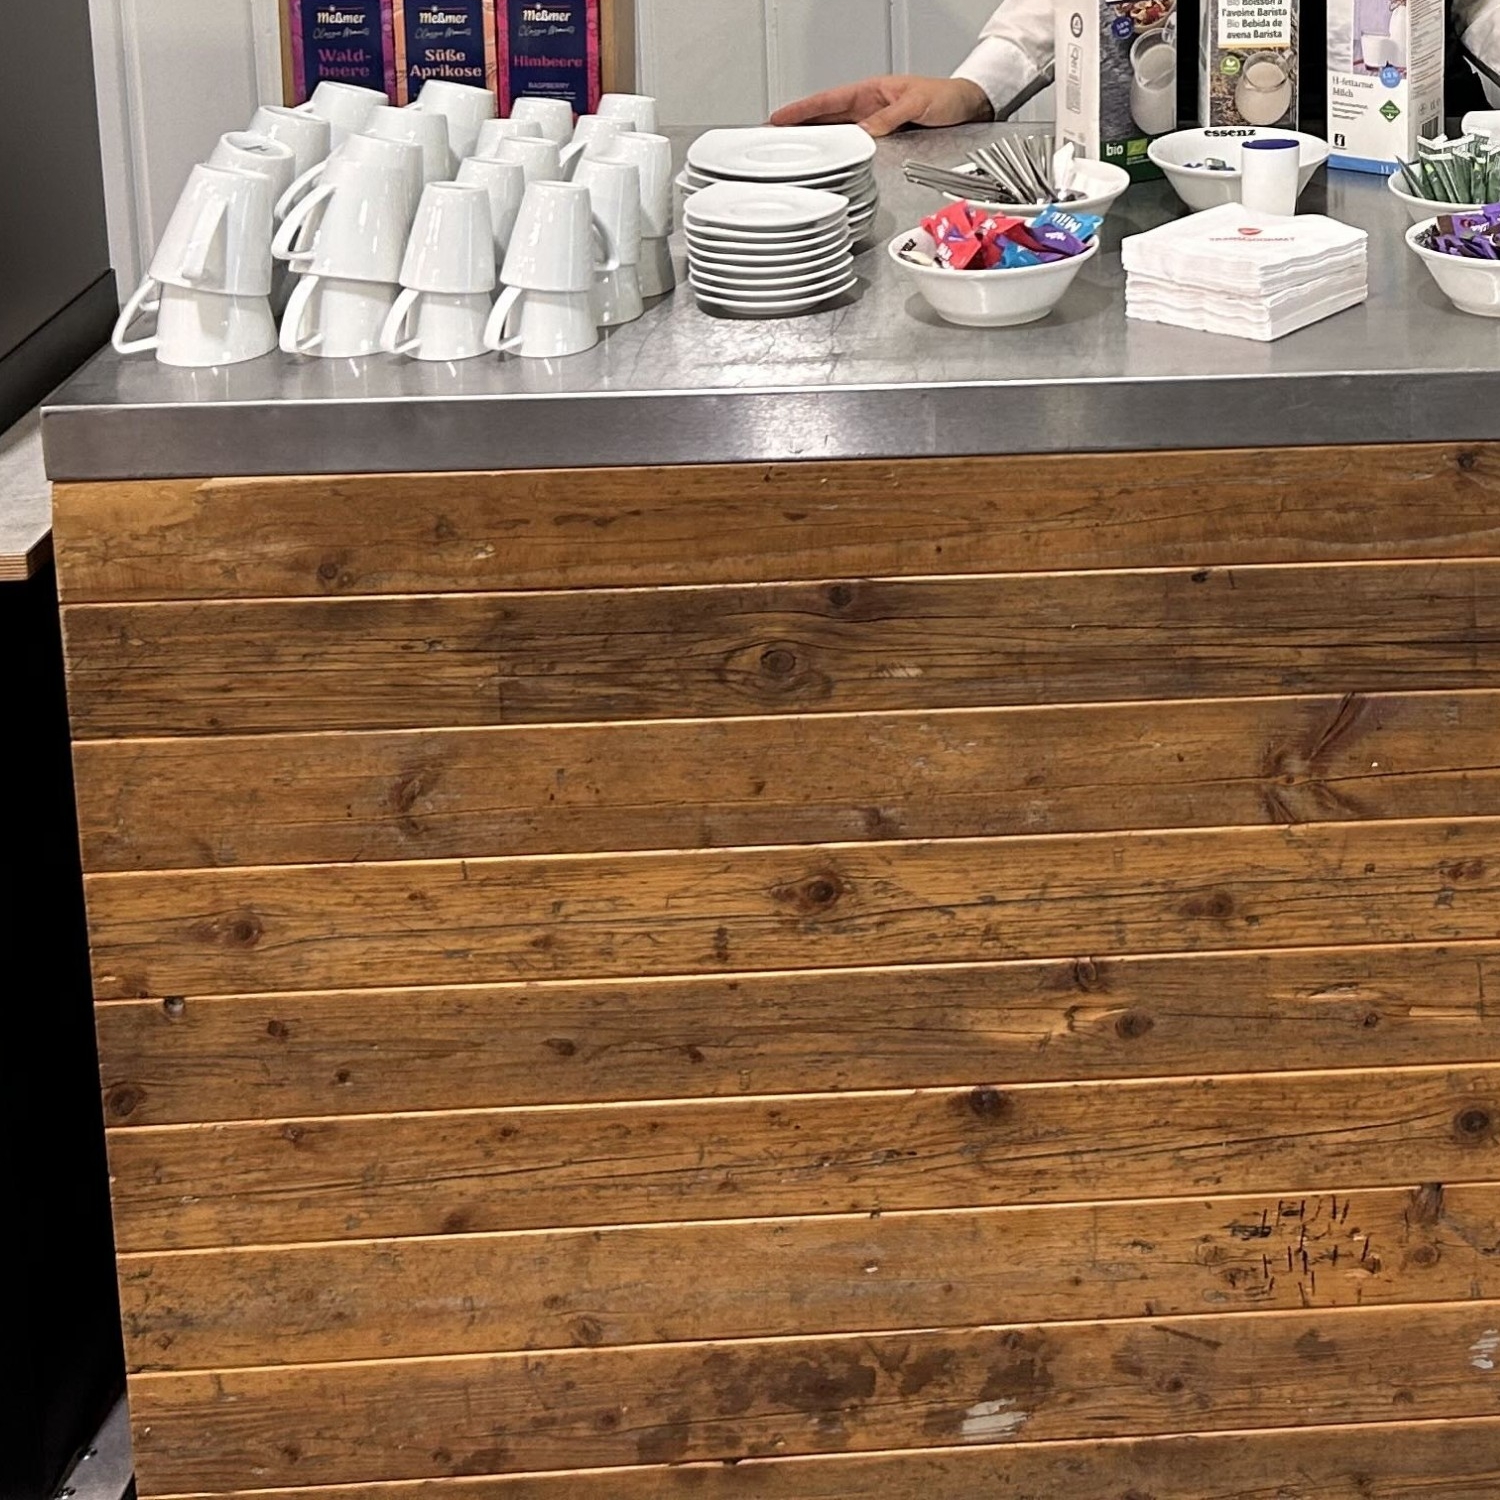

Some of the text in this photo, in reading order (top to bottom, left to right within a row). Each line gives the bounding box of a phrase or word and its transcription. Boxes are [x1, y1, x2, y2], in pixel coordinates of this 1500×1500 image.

[317, 11, 367, 24] Meßmer
[419, 11, 469, 24] Meßmer
[522, 9, 572, 22] Meßmer
[1257, 7, 1288, 17] Barista
[1242, 18, 1271, 28] Bebida
[1226, 29, 1283, 39] avena Barista
[318, 48, 372, 63] Wald-
[424, 48, 466, 62] Süße
[513, 55, 583, 68] Himbeere
[318, 65, 370, 78] beere
[409, 64, 482, 80] Aprikose
[1332, 87, 1354, 98] Milch
[1105, 142, 1124, 157] bio
